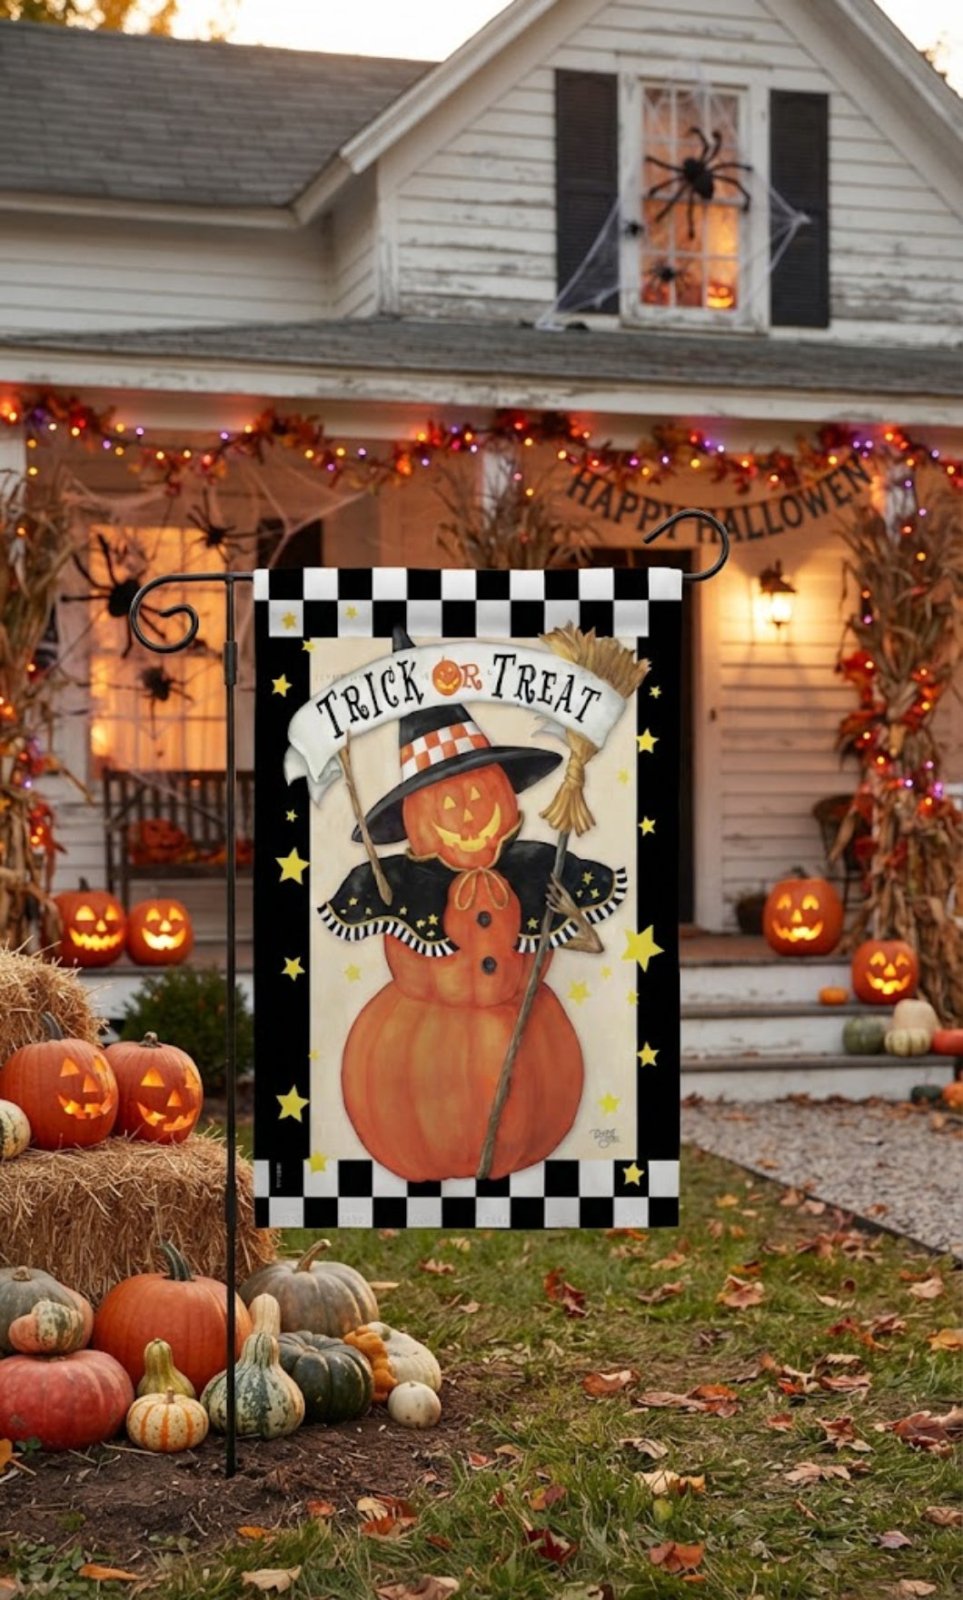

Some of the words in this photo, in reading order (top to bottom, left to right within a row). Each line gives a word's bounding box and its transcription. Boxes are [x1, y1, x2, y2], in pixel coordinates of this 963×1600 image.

[567, 470, 681, 539] HAPPY
[696, 454, 873, 543] HALLOWEN
[316, 660, 424, 739] TRICK
[491, 653, 602, 723] TREAT
